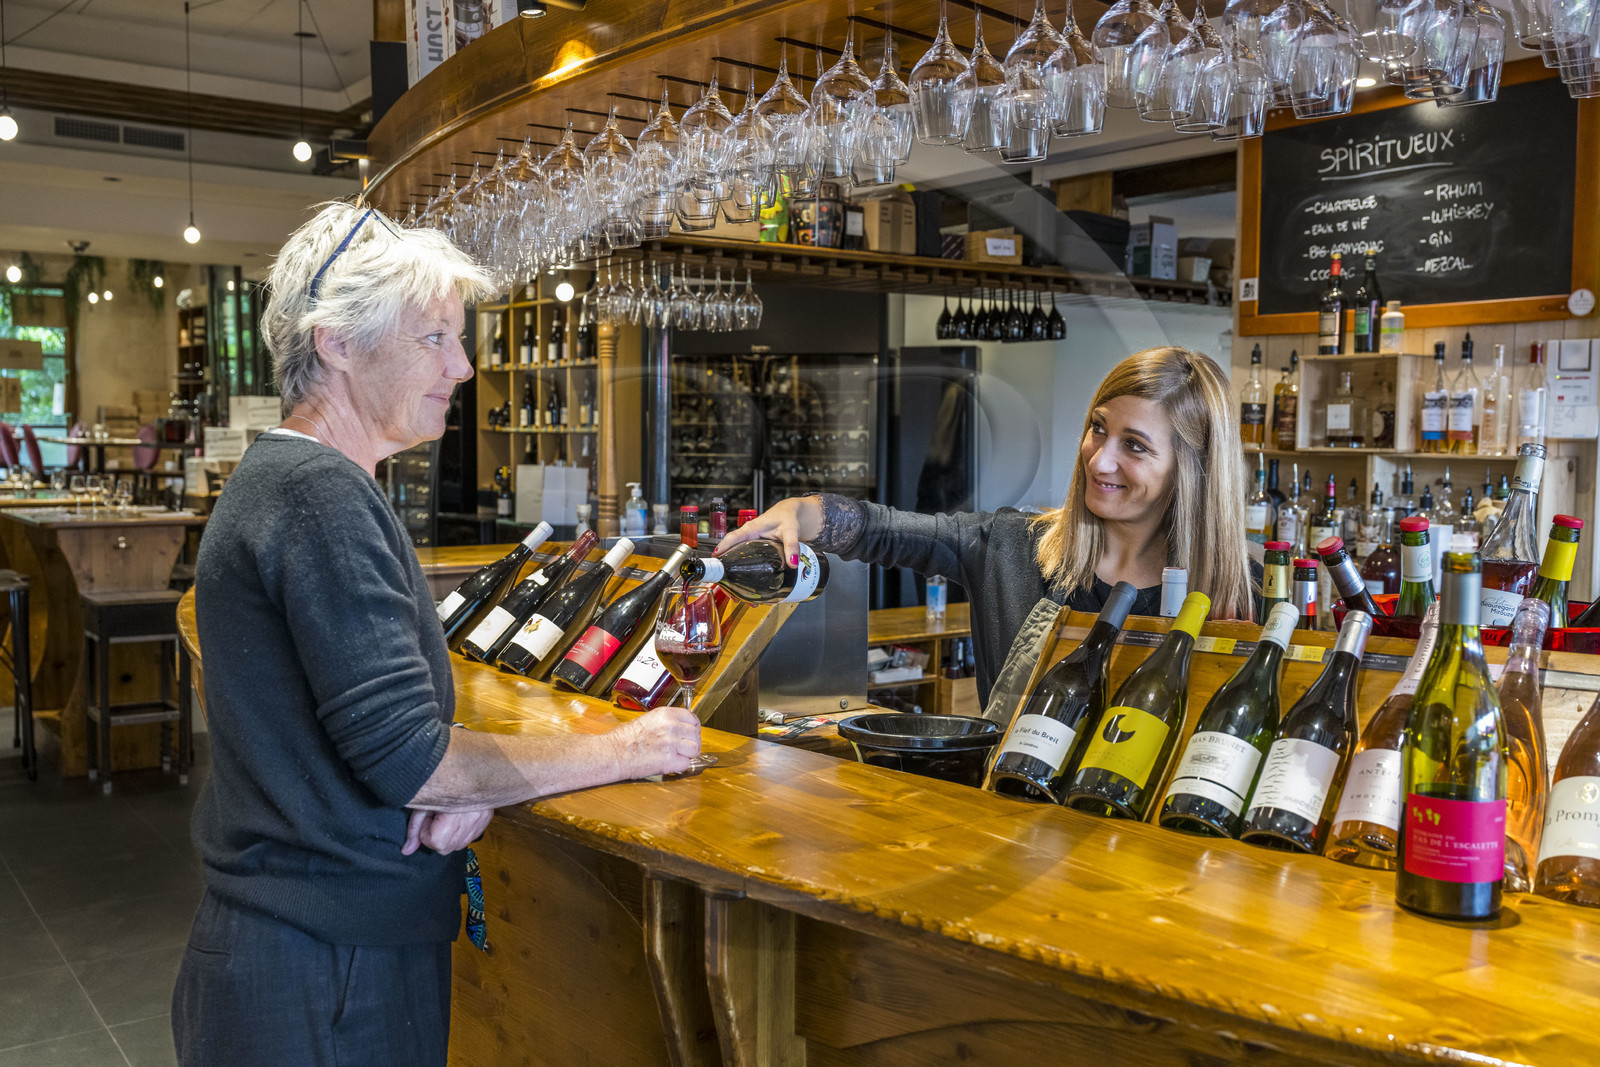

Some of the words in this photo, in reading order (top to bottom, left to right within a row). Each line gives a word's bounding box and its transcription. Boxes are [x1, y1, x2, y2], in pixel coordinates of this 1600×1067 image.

[1336, 220, 1349, 232] DE
[1491, 608, 1514, 618] Mirouze
[1031, 728, 1041, 737] du
[1041, 730, 1059, 745] Breil
[1208, 735, 1246, 753] BRUNET
[1556, 809, 1599, 823] Prom
[1430, 838, 1442, 847] DE
